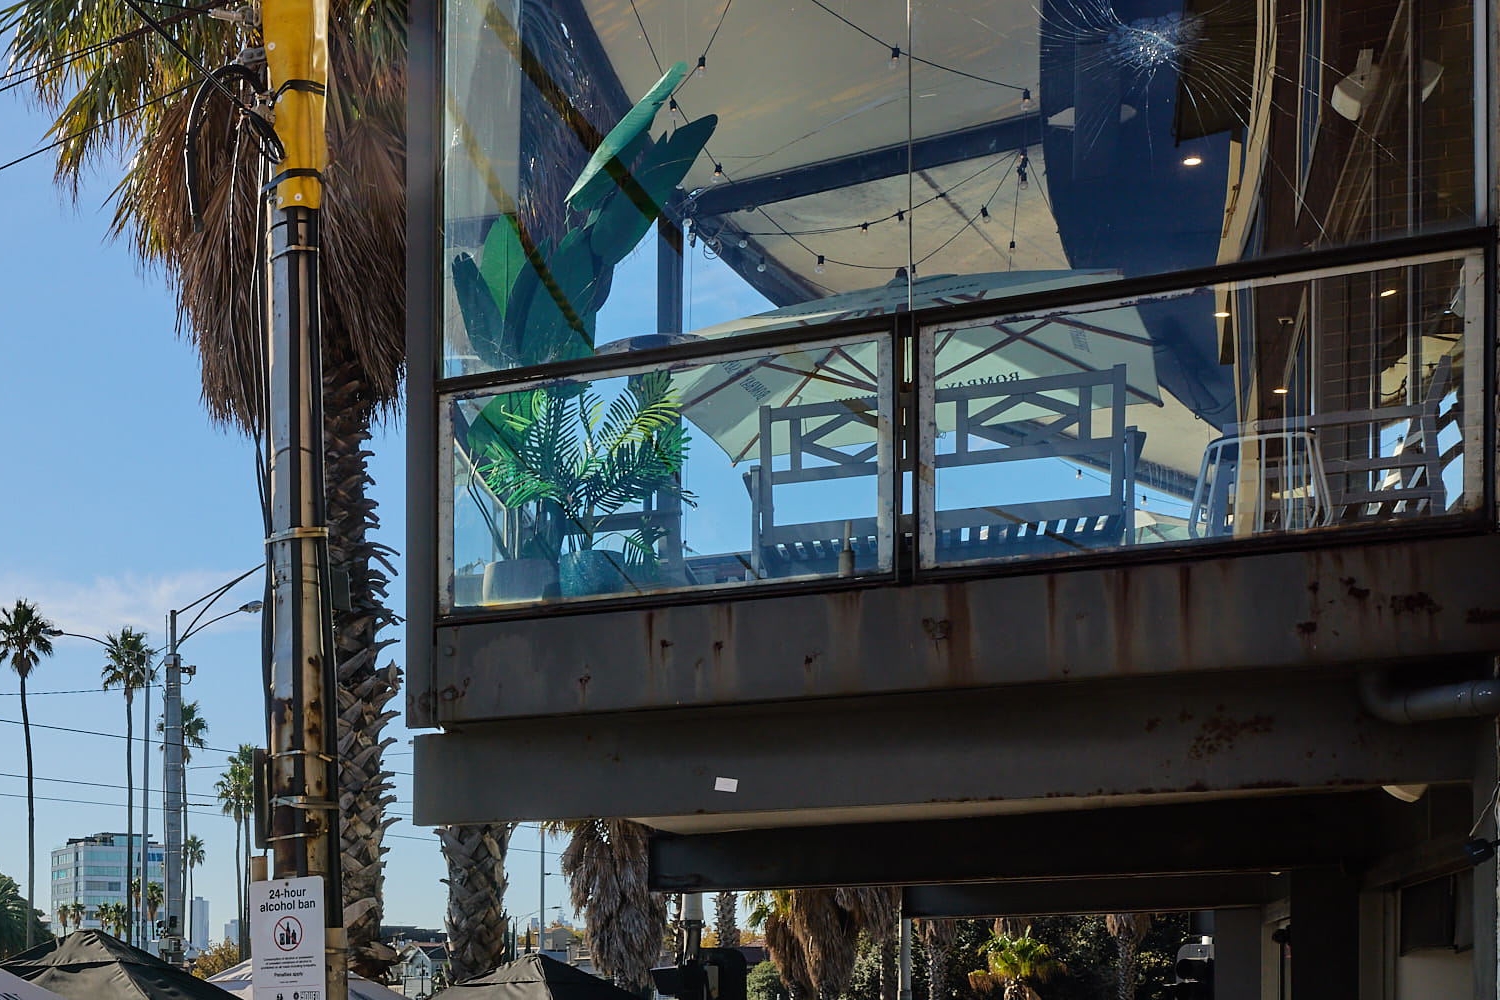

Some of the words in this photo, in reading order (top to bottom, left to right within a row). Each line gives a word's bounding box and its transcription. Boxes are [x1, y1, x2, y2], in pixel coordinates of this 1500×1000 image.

[269, 888, 306, 899] 24-hour
[260, 900, 295, 912] alcohol
[298, 900, 315, 909] ban
